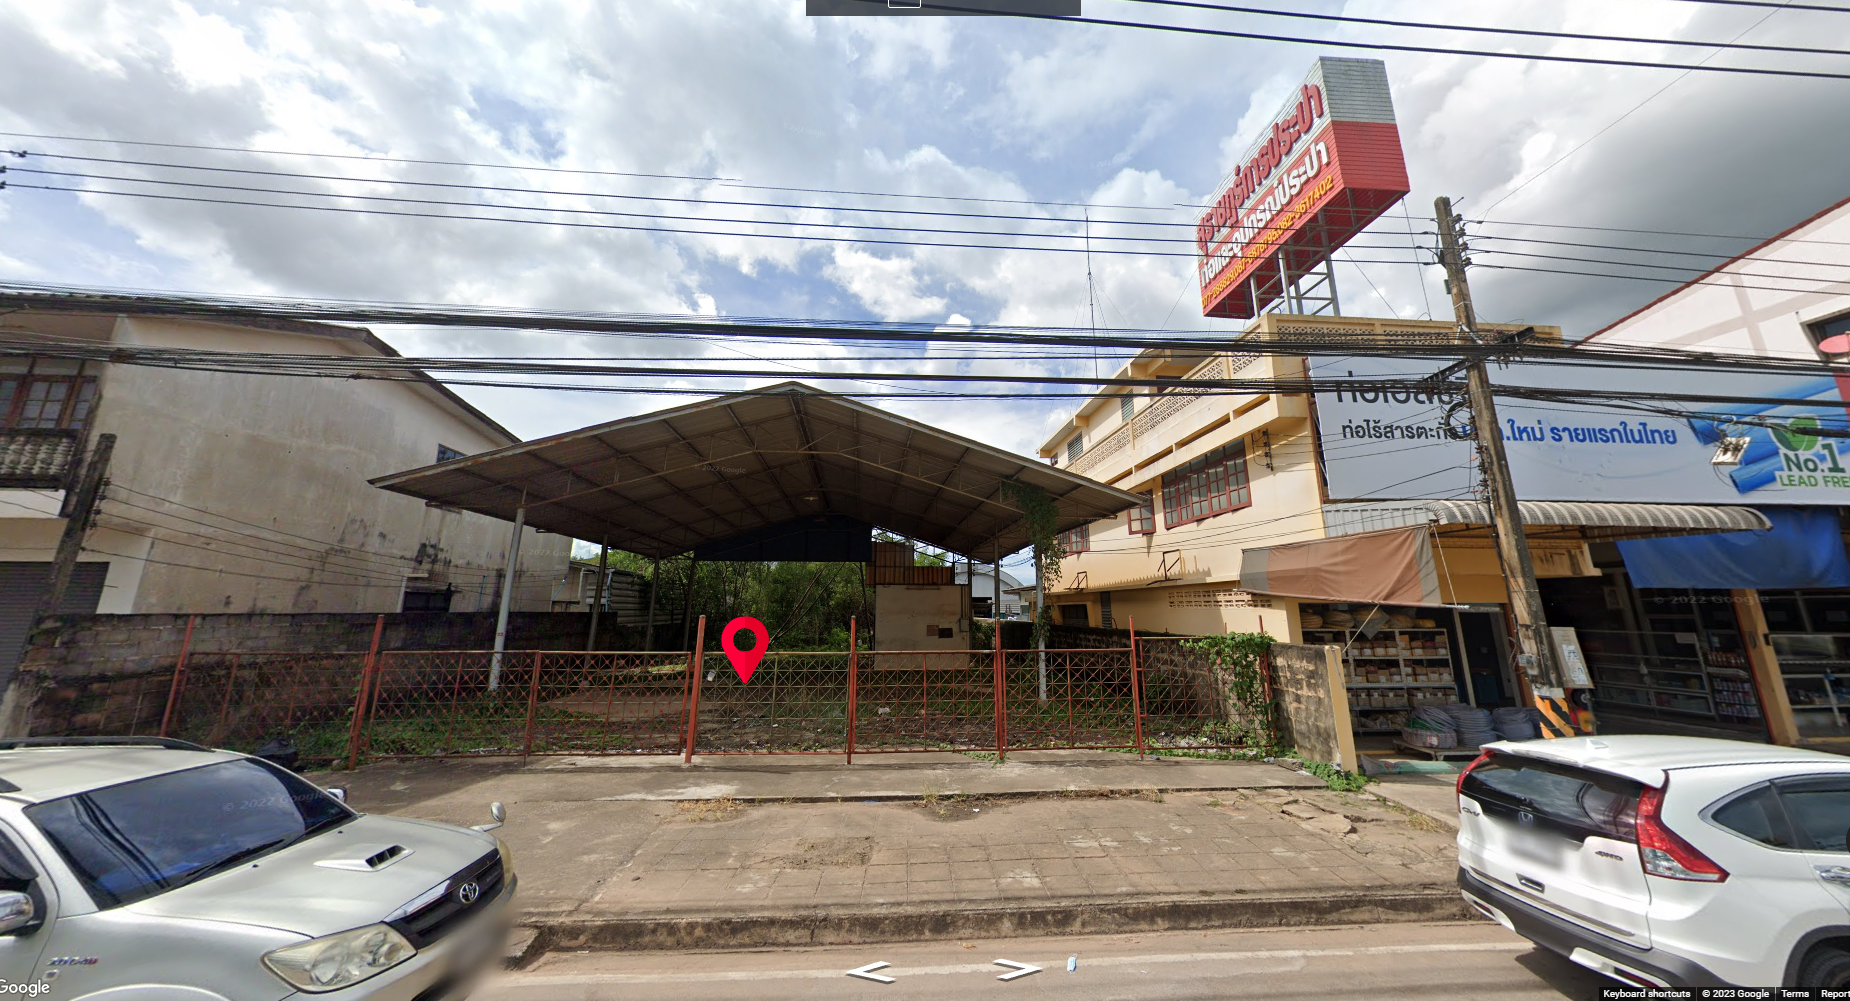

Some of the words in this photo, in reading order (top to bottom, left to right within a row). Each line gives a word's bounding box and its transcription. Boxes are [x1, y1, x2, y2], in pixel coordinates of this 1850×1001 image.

[1550, 421, 1678, 445] รายแรกในไทย
[1778, 474, 1818, 487] LEAD
[1595, 850, 1624, 862] 4WD
